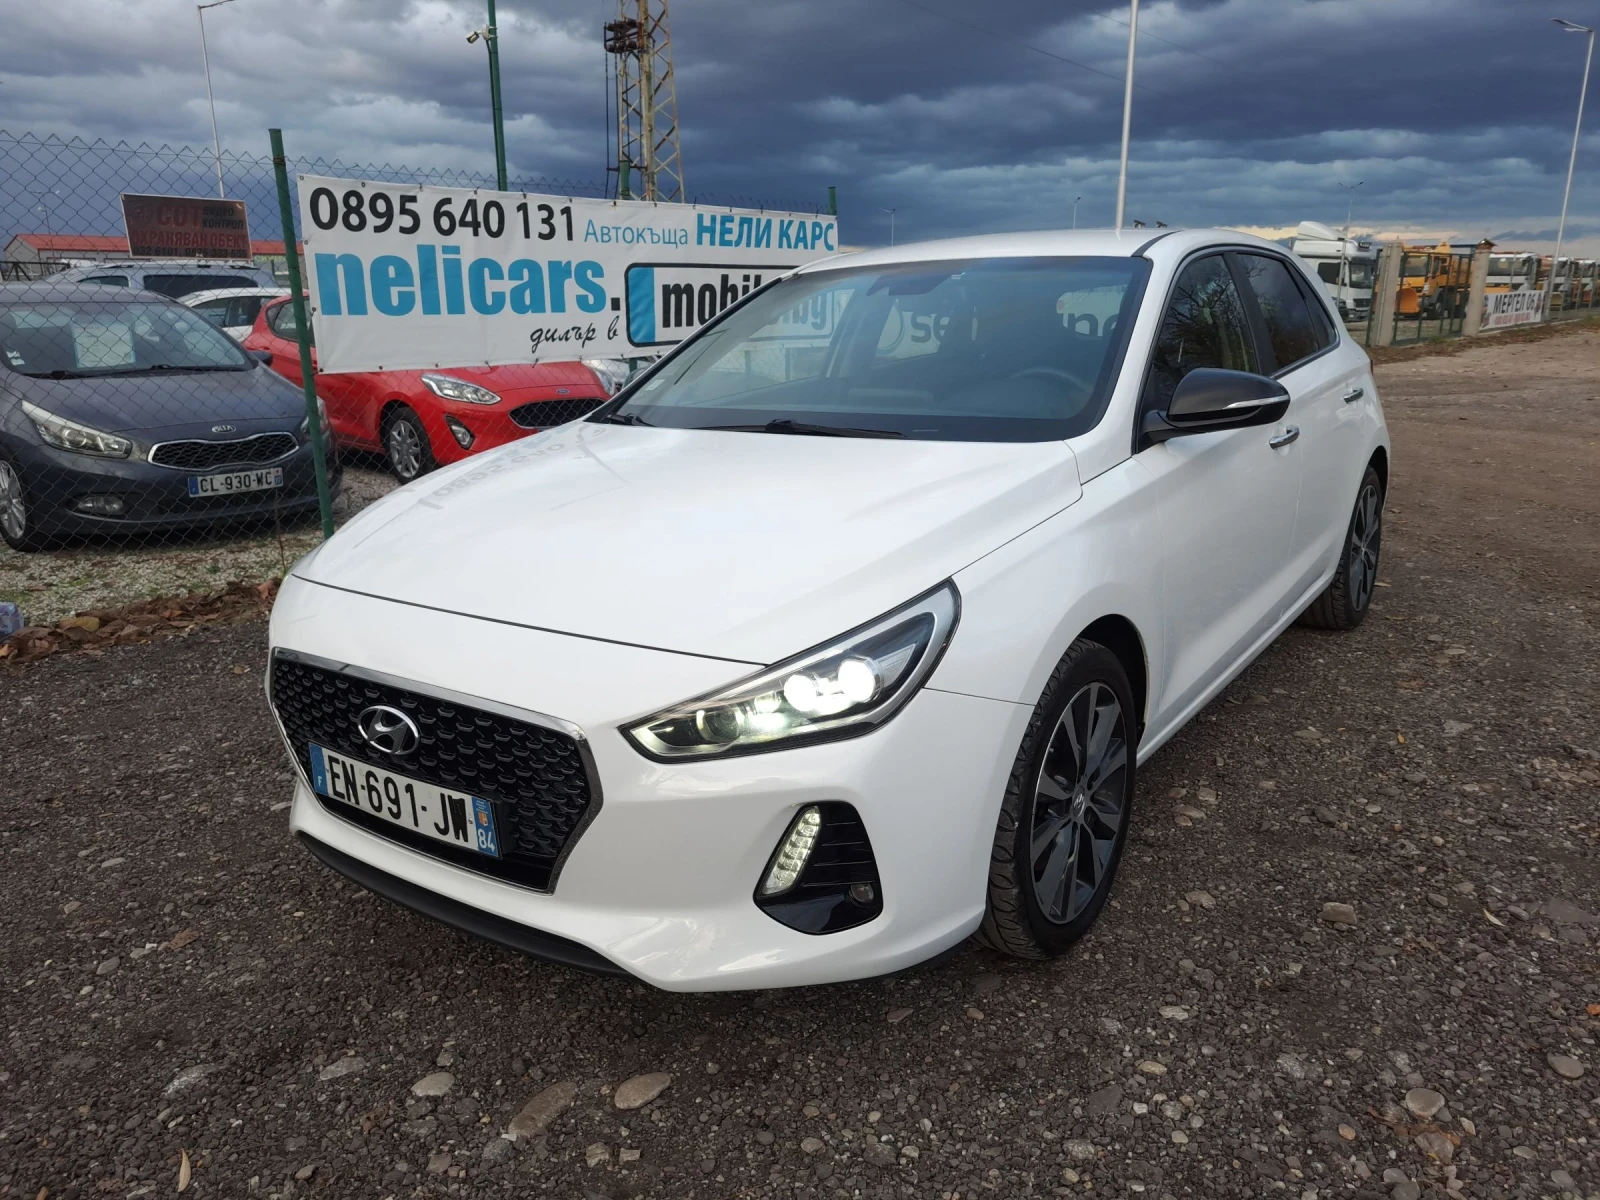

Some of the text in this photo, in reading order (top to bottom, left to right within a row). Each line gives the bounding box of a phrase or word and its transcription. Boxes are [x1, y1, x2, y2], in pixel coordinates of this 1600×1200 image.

[203, 218, 244, 230] КОНТРОЛ
[309, 186, 574, 242] 0895 640 131
[584, 212, 835, 252] Автокъща НЕЛИ КАРС
[530, 322, 598, 352] дилър
[200, 471, 273, 493] CL-930-WC
[328, 755, 469, 843] EN-691-JW
[478, 828, 496, 852] 84
